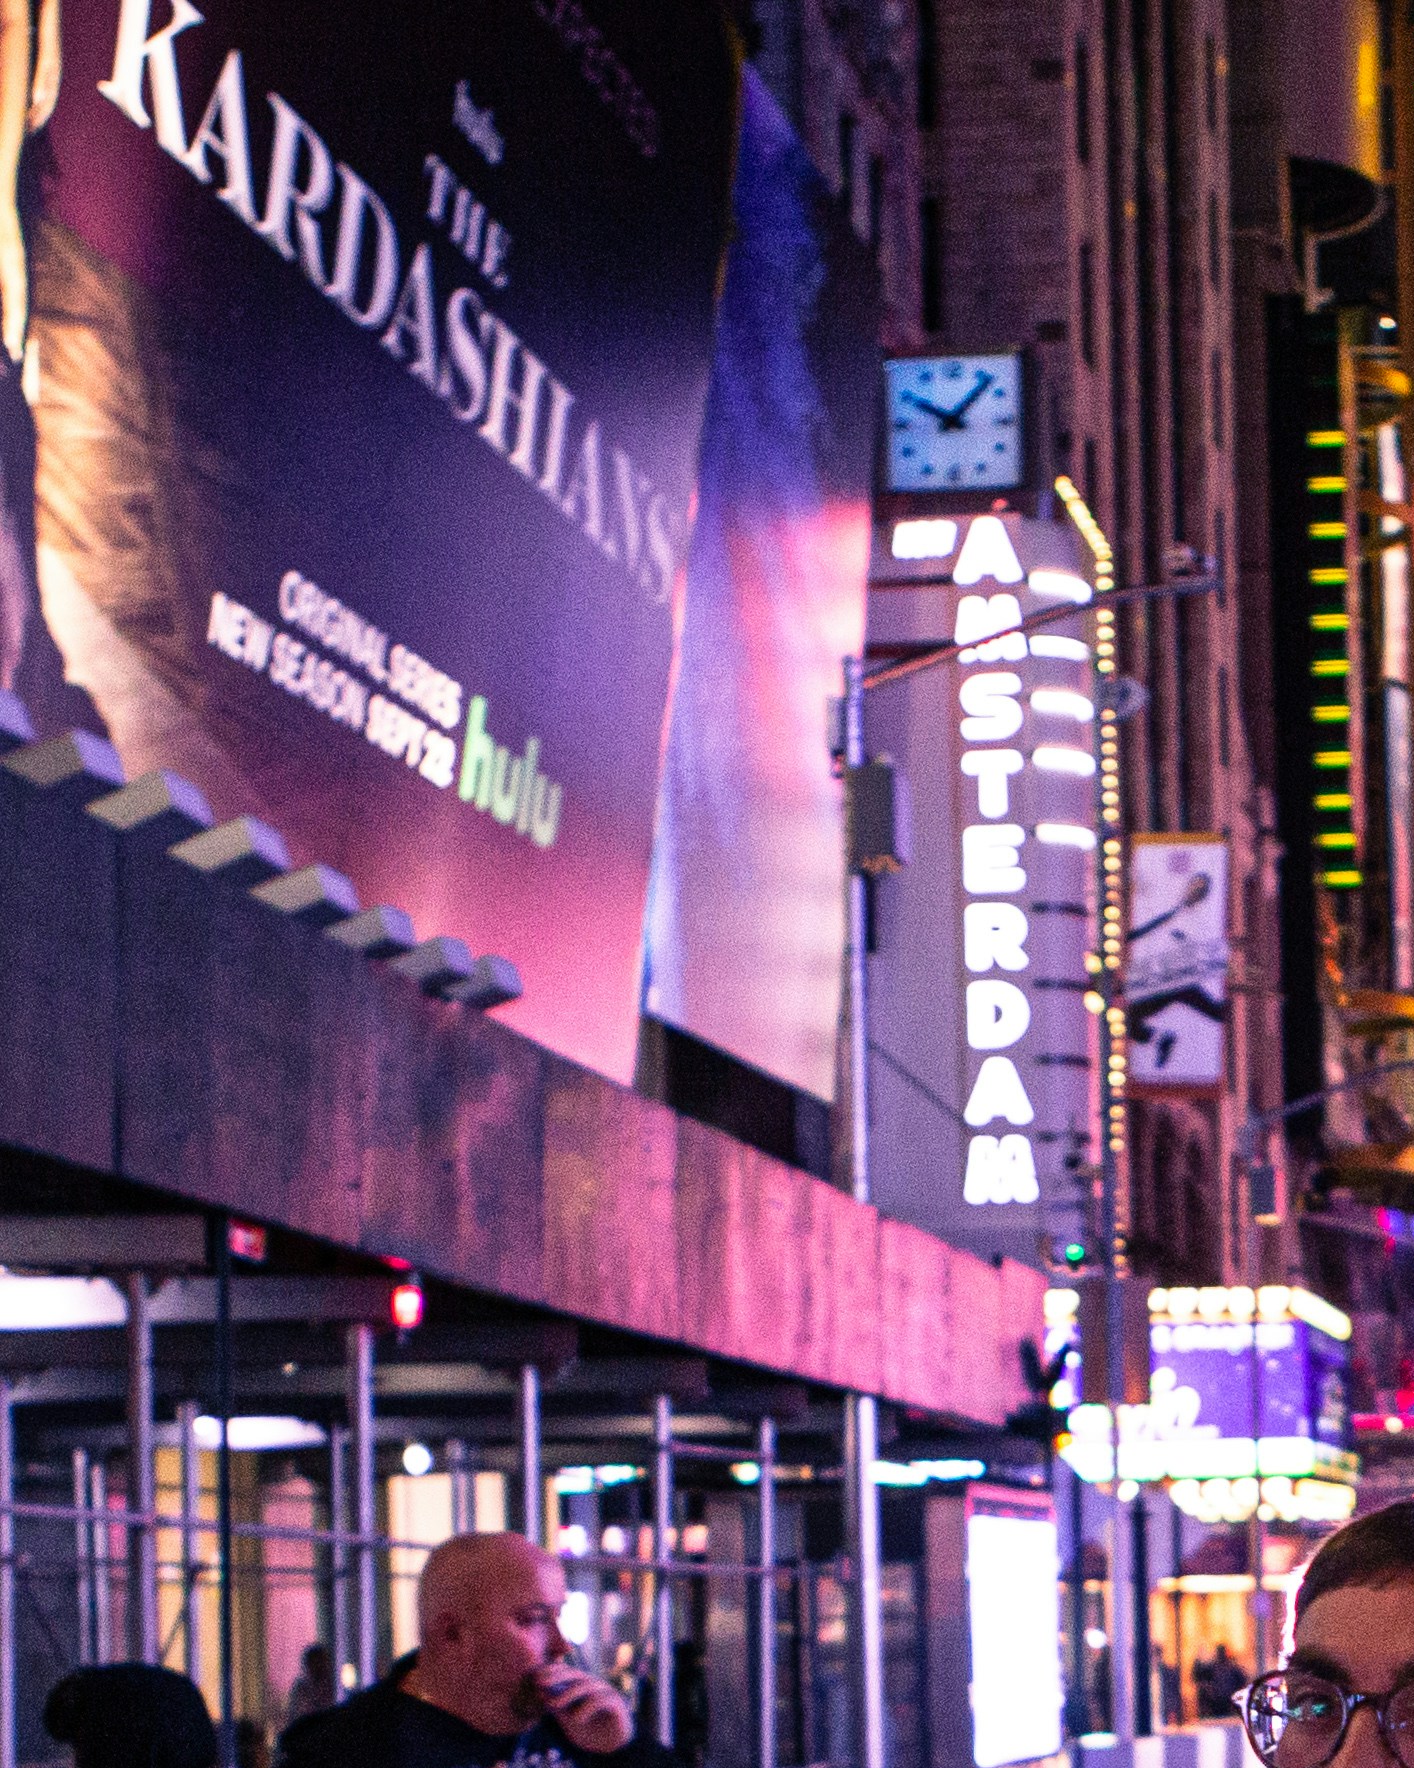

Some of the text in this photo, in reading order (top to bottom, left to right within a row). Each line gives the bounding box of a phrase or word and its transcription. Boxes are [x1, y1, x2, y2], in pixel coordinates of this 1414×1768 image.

[97, 0, 686, 604] KARDASHIANS
[424, 152, 512, 288] THE
[458, 694, 563, 848] hulu
[952, 515, 1041, 1206] AMSTERDAM
